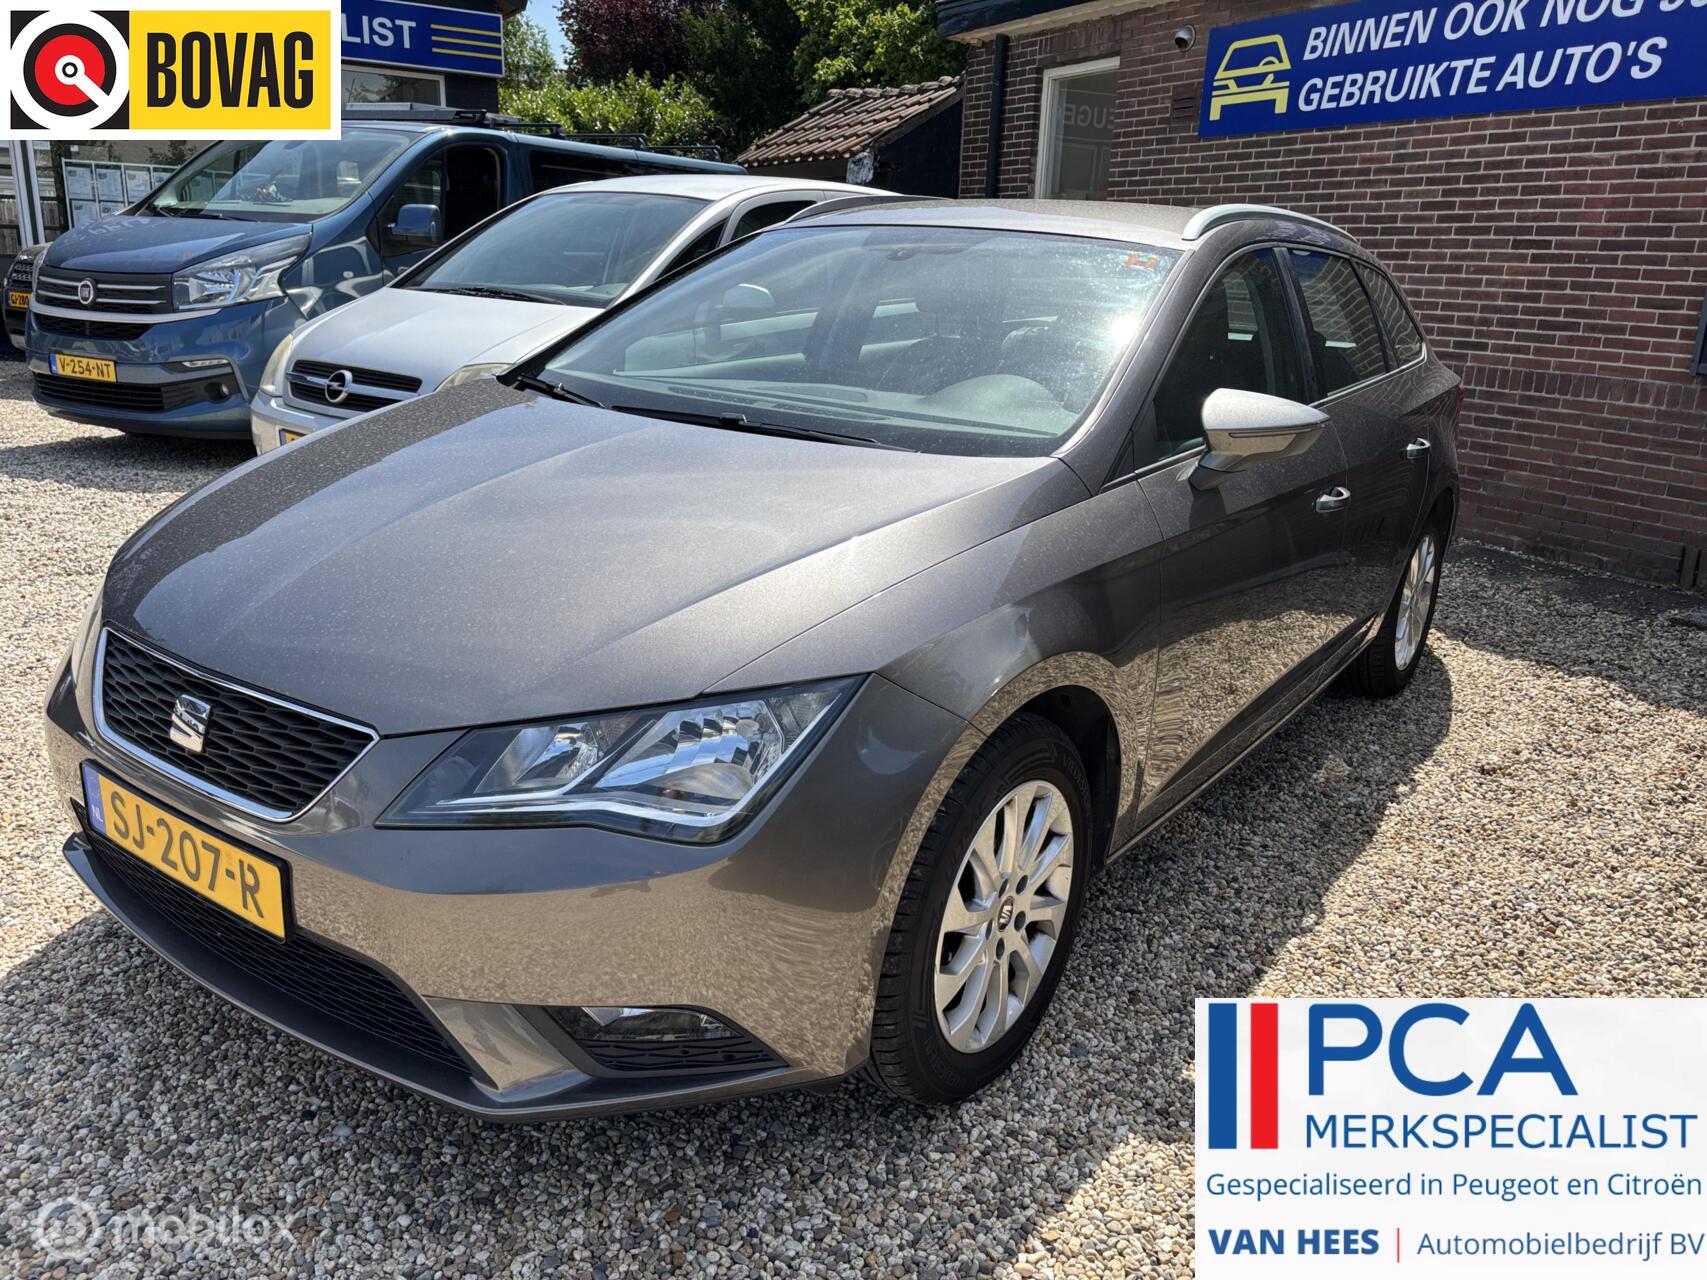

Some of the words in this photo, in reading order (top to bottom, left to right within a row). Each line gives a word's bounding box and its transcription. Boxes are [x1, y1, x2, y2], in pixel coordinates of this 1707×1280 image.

[1303, 7, 1438, 61] BINNEN
[1443, 0, 1530, 40] OOK
[1298, 55, 1497, 112] GEBRUIKTE
[1495, 36, 1668, 92] AUTO'S
[59, 356, 111, 379] V-254-NT
[110, 790, 265, 919] SJ-207-R
